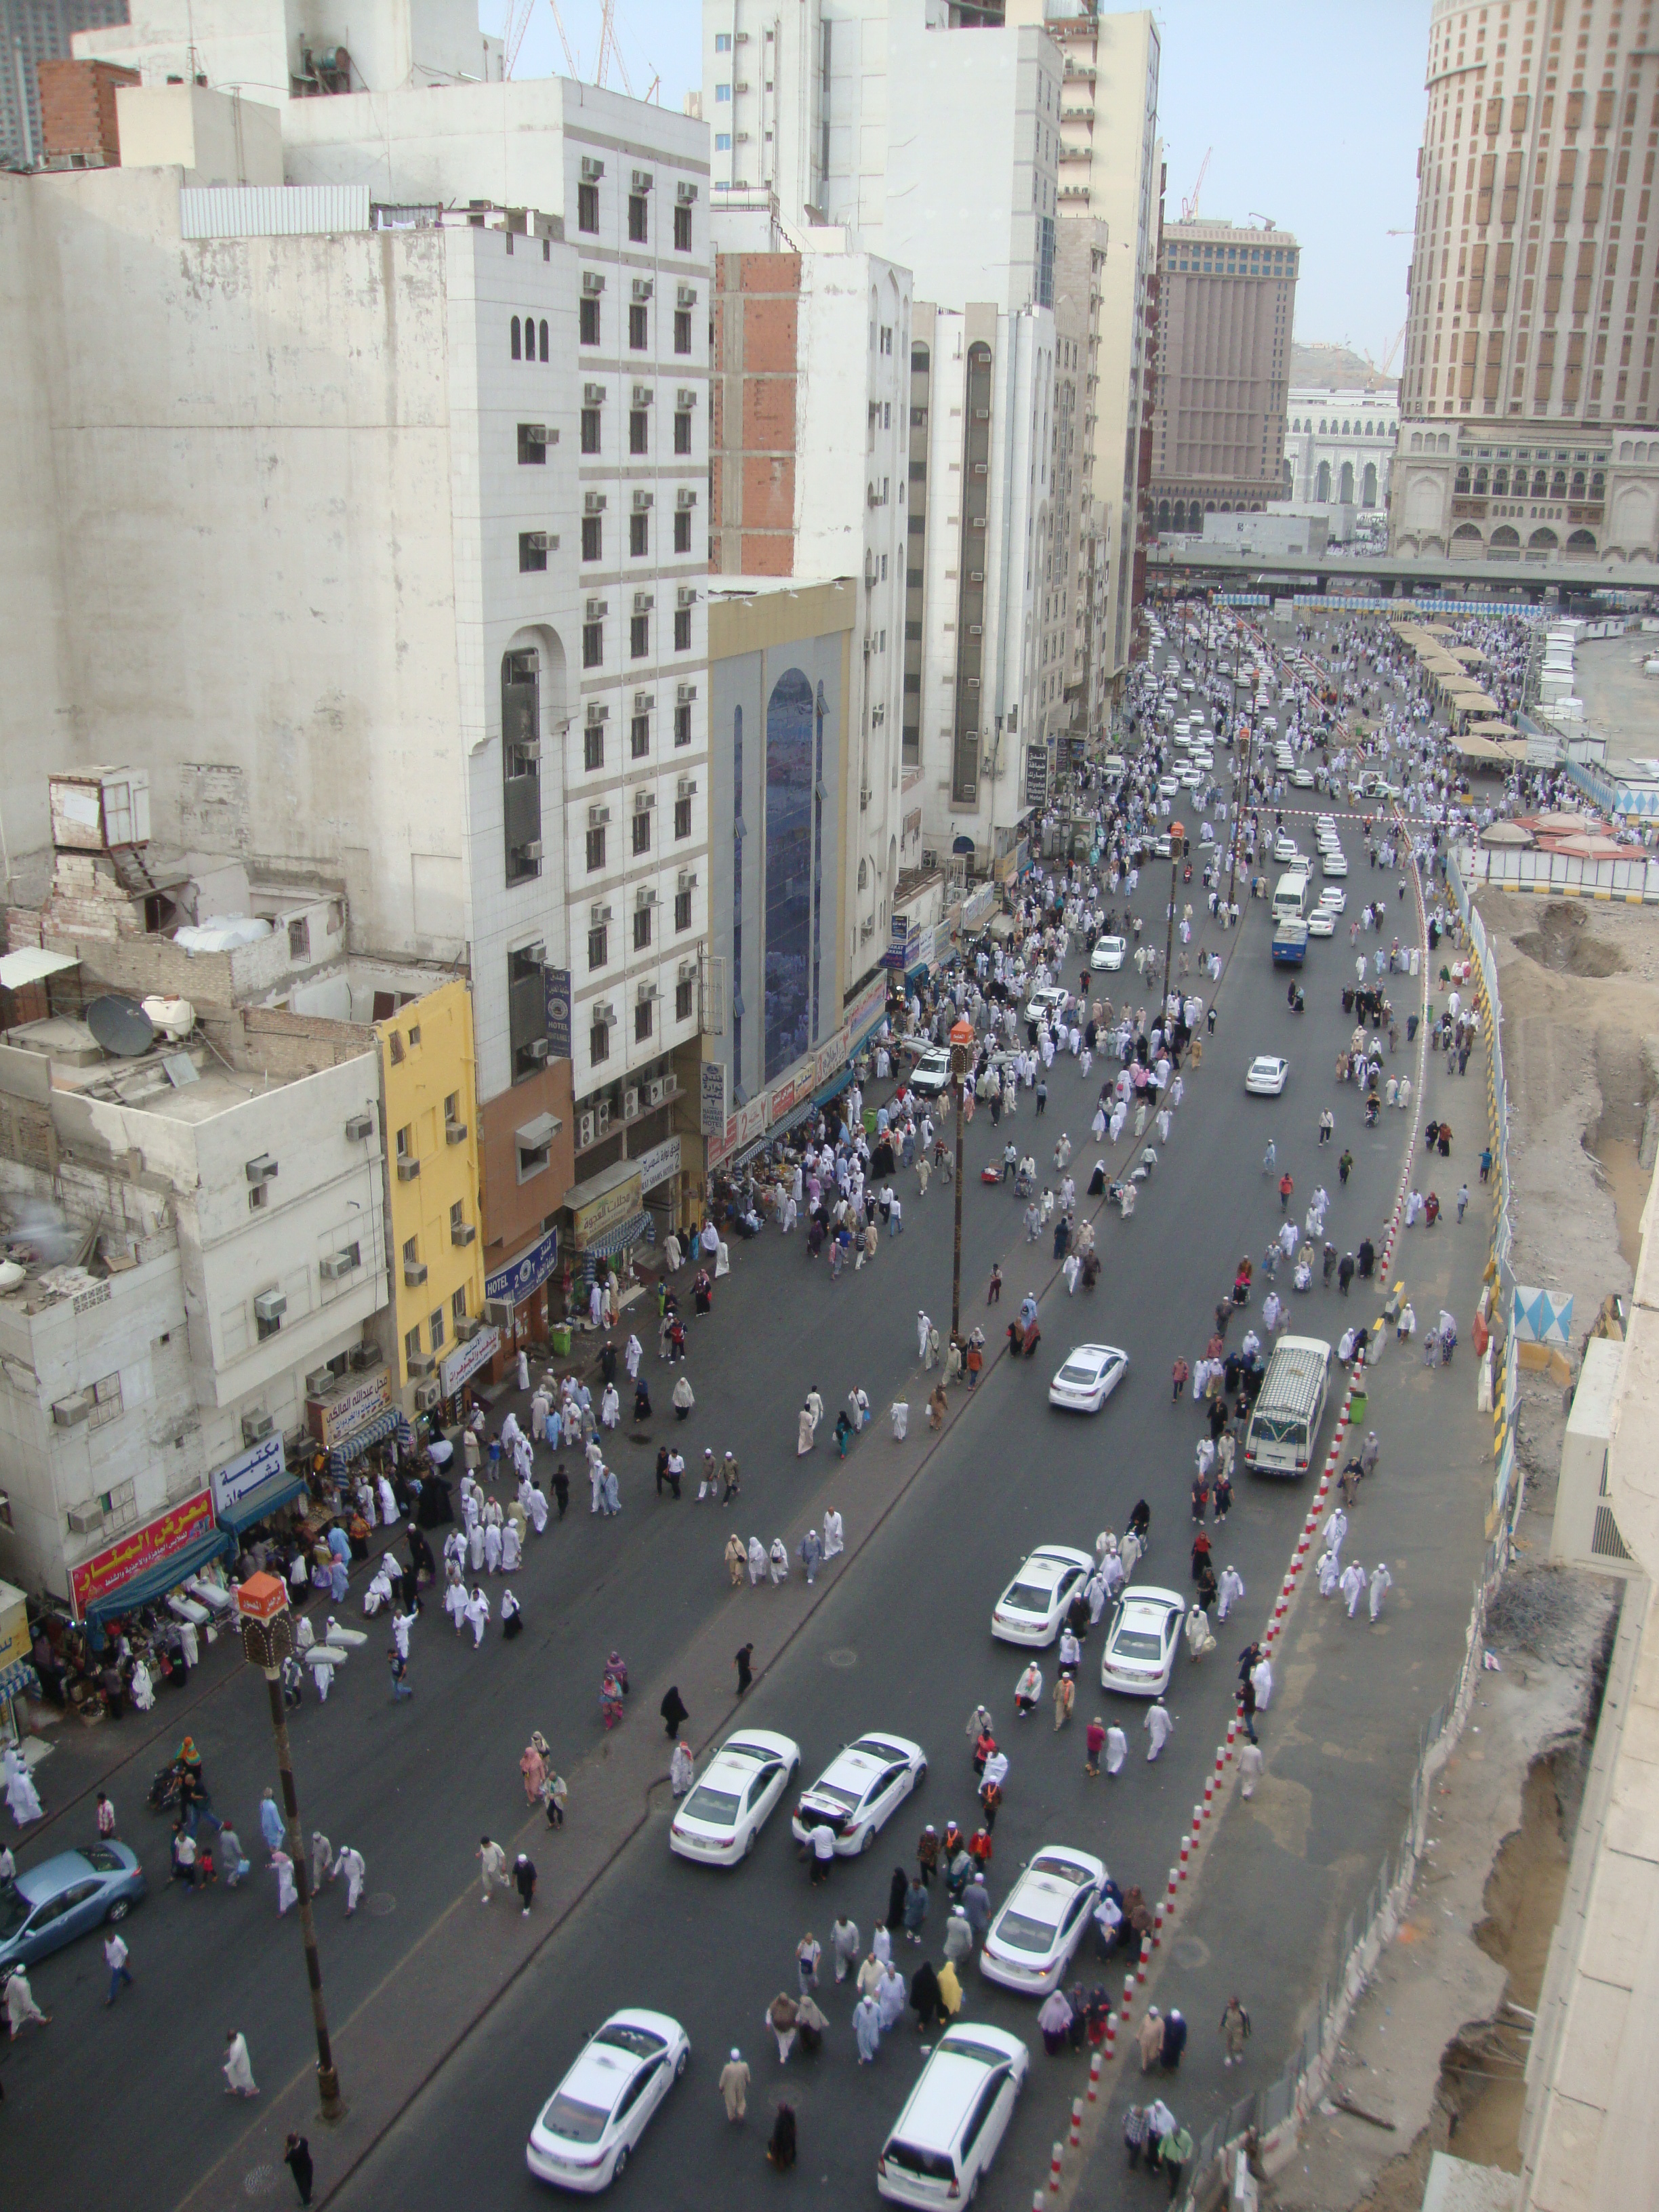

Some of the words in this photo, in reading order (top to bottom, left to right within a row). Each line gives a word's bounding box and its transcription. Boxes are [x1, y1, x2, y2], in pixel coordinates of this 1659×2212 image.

[1028, 761, 1045, 771] ضيافة
[1029, 752, 1046, 760] فندق
[1028, 771, 1045, 780] مبارك
[548, 1021, 568, 1030] HOTEL
[702, 1073, 722, 1082] فندق
[703, 1082, 722, 1092] نوارة
[741, 1112, 747, 1142] 2
[670, 1140, 680, 1158] فندق
[649, 1170, 662, 1185] SHAMS
[662, 1163, 674, 1177] HOTEL
[674, 1153, 680, 1169] 2
[607, 1193, 630, 1213] محلات
[583, 1206, 606, 1229] العجوة
[540, 1237, 551, 1261] فندق
[487, 1275, 508, 1296] HOTEL
[514, 1274, 519, 1288] 2
[375, 1376, 387, 1393] محل
[352, 1385, 373, 1406] عبدالله
[327, 1397, 351, 1425] المالكي
[222, 1442, 279, 1486] مكتبة
[225, 1460, 280, 1510] نشوان
[155, 1499, 208, 1547] معرض
[169, 1531, 187, 1549] للملابس
[79, 1530, 149, 1591] المنار
[148, 1542, 168, 1560] الجاهزة
[105, 1572, 125, 1586] والشنط
